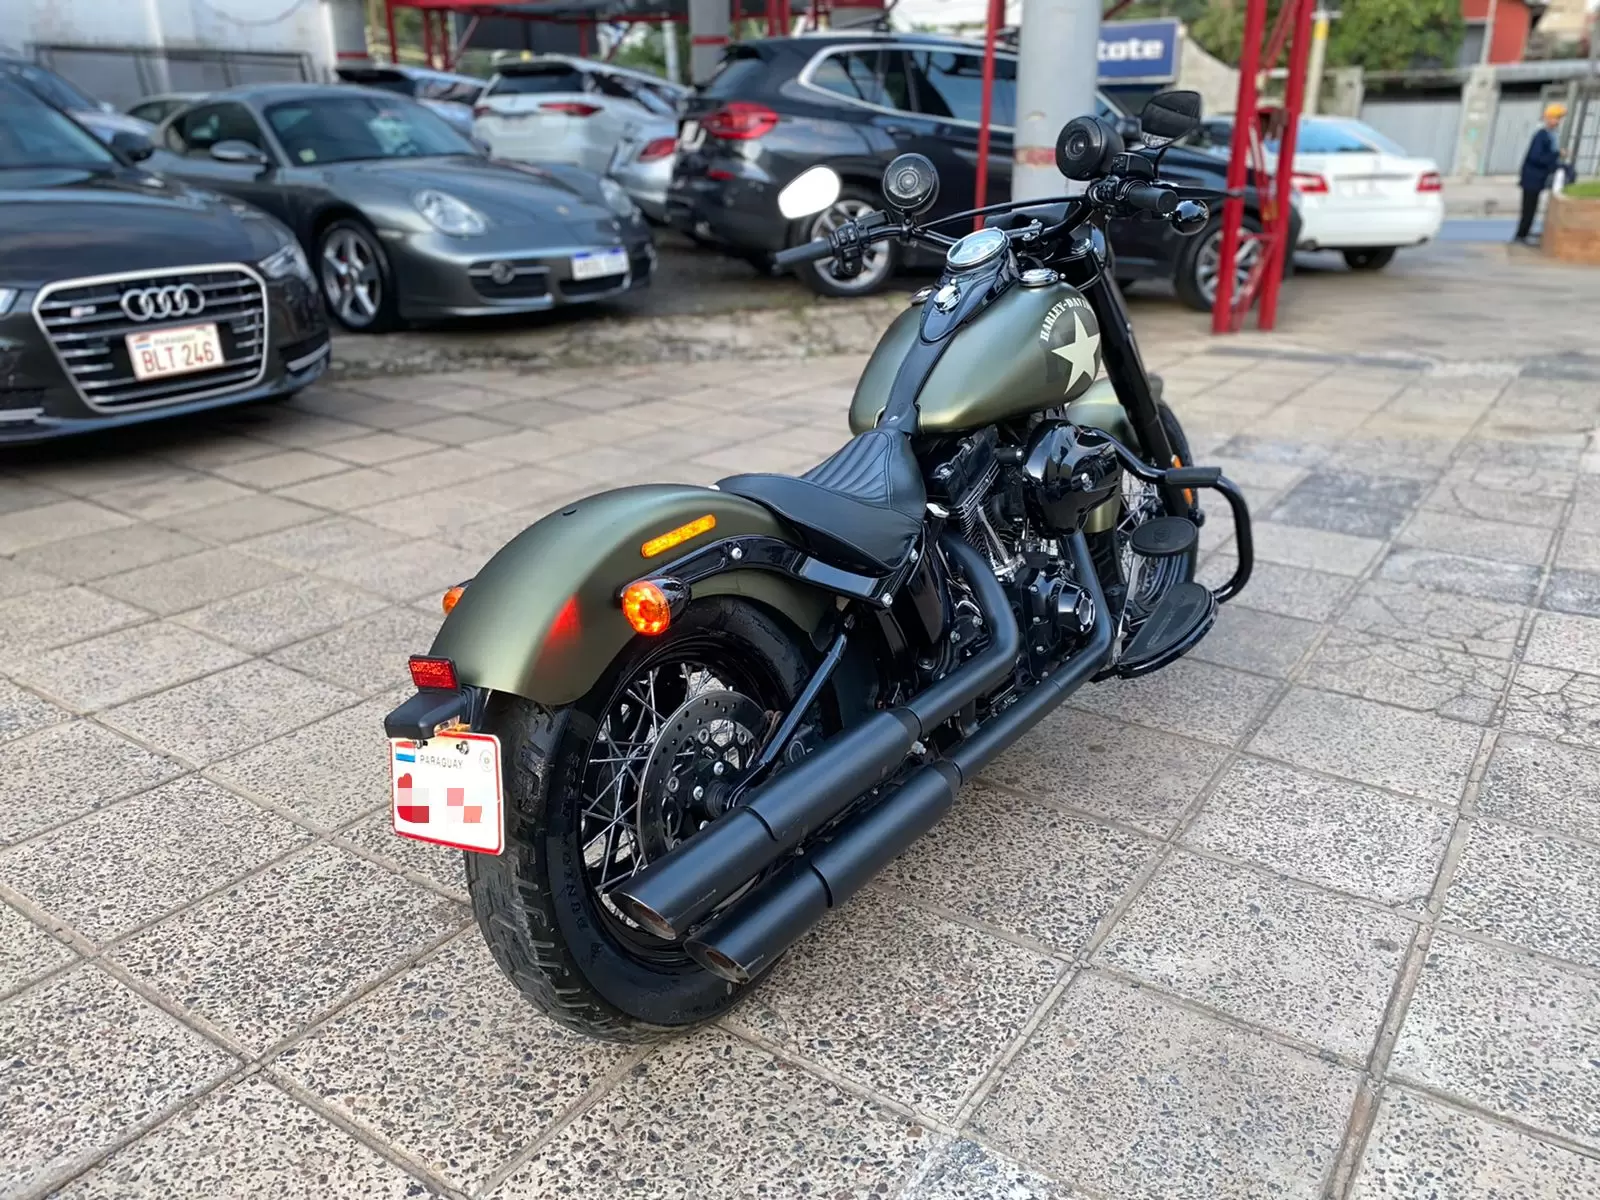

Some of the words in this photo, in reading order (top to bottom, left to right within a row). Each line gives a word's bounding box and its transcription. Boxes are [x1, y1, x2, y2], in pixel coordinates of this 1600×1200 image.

[141, 347, 177, 374] BLT
[182, 341, 215, 366] 246
[420, 754, 464, 769] PARAGUAY
